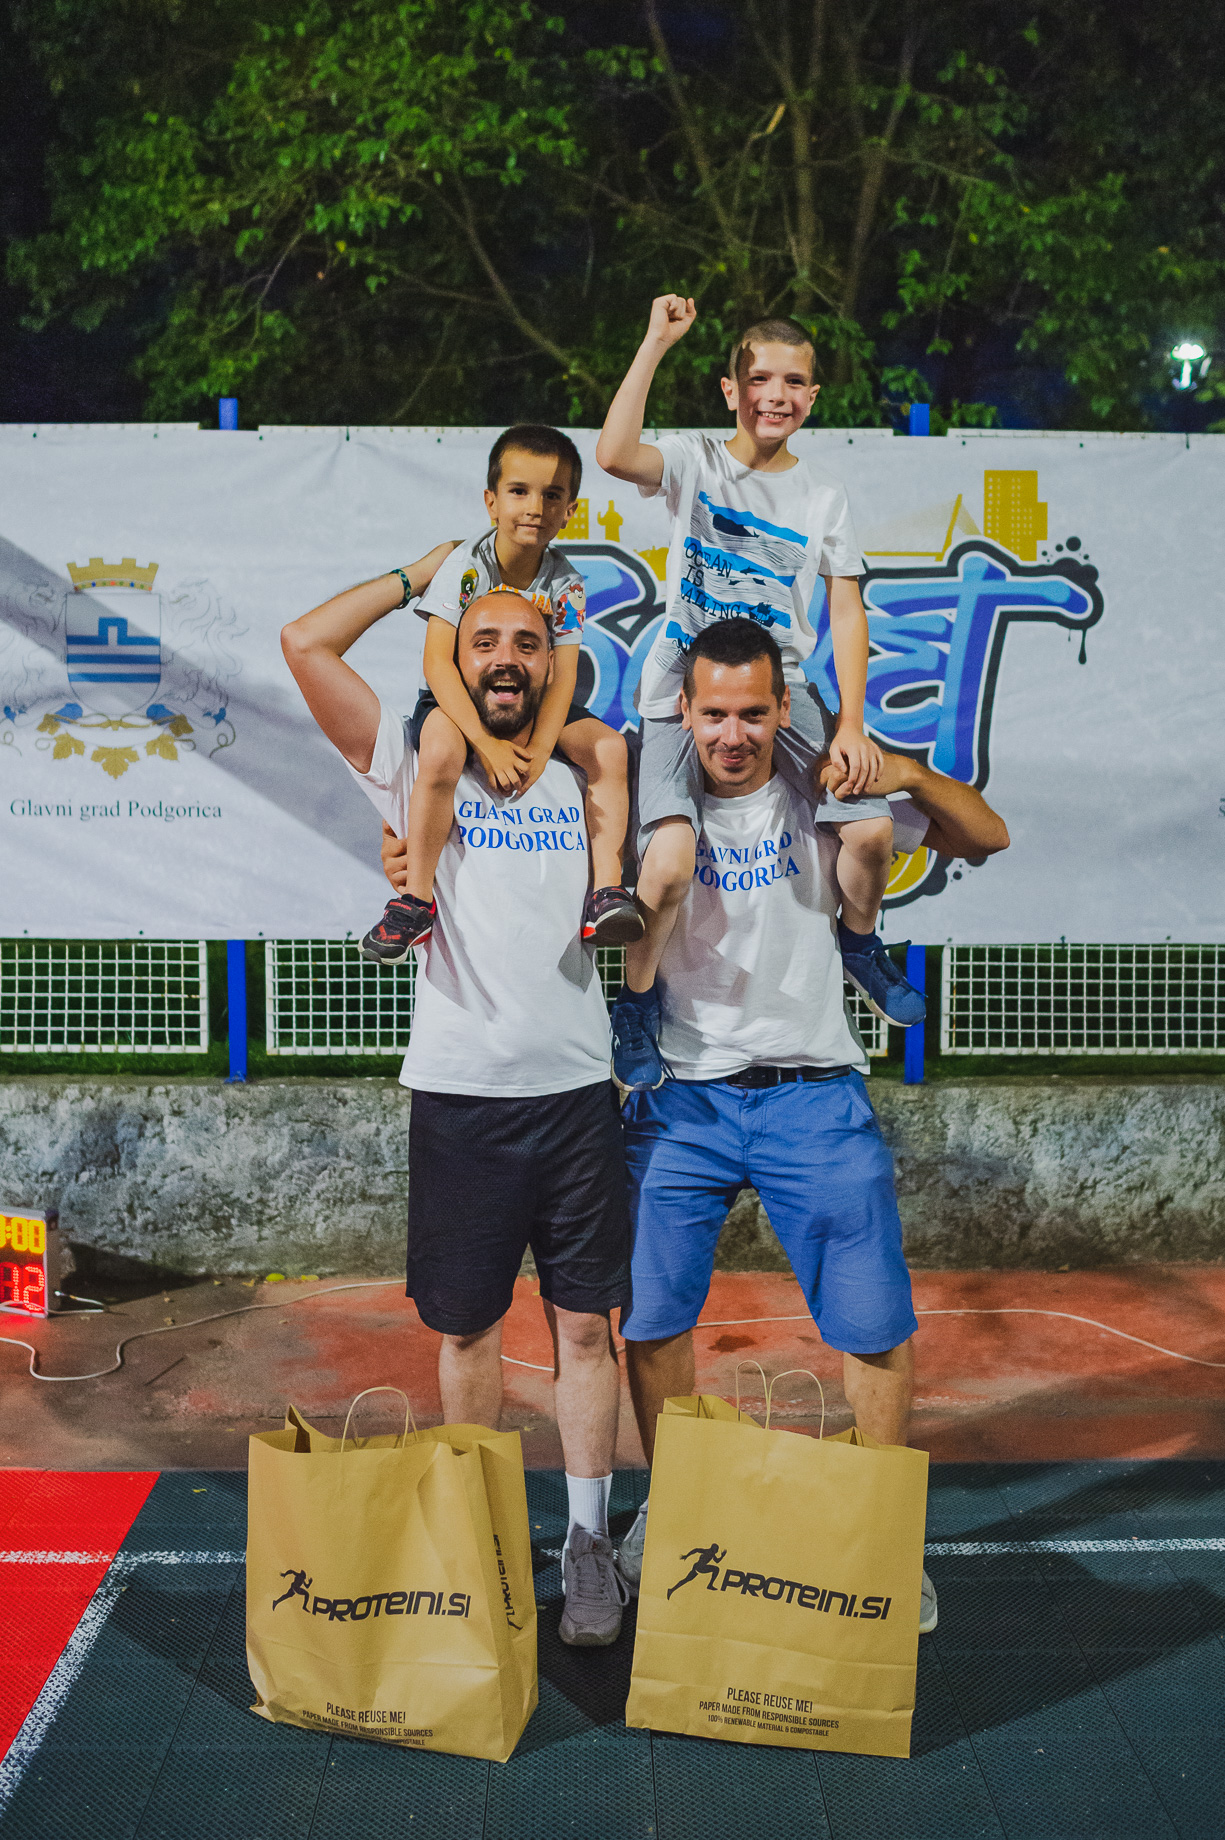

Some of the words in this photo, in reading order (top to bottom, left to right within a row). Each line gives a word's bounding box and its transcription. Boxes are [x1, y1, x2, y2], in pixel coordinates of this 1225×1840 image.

[685, 542, 733, 579] OCEAN
[682, 564, 705, 588] IS
[680, 583, 742, 622] ALLING
[10, 799, 73, 817] Glavni
[79, 800, 120, 822] grad
[128, 800, 223, 822] Podgorica
[458, 800, 524, 826] GLANI
[528, 806, 580, 825] GRAD
[457, 825, 586, 852] PODGORICA
[754, 831, 792, 860] GRD
[312, 1591, 471, 1622] PROTEINI.SI
[720, 1569, 892, 1620] PROTEINI.SI
[326, 1702, 356, 1721] PLEASE
[358, 1710, 387, 1723] REUSE
[389, 1711, 406, 1724] ME!
[727, 1687, 761, 1705] PLEASE
[763, 1693, 793, 1710] REUSE
[795, 1699, 813, 1713] ME!
[302, 1710, 321, 1722] PAPER
[322, 1714, 340, 1727] MADE
[341, 1721, 359, 1731] FROM
[403, 1728, 433, 1737] SOURCES
[699, 1701, 720, 1711] PAPER
[721, 1703, 741, 1715] MADE
[742, 1706, 761, 1718] FROM
[762, 1710, 807, 1726] RESPONSIBLE
[808, 1717, 840, 1729] SOURCES
[708, 1714, 723, 1724] 100%
[724, 1716, 756, 1728] RENEWABLE
[757, 1721, 784, 1733] MATERIAL
[790, 1726, 829, 1737] COMPOSTABLE
